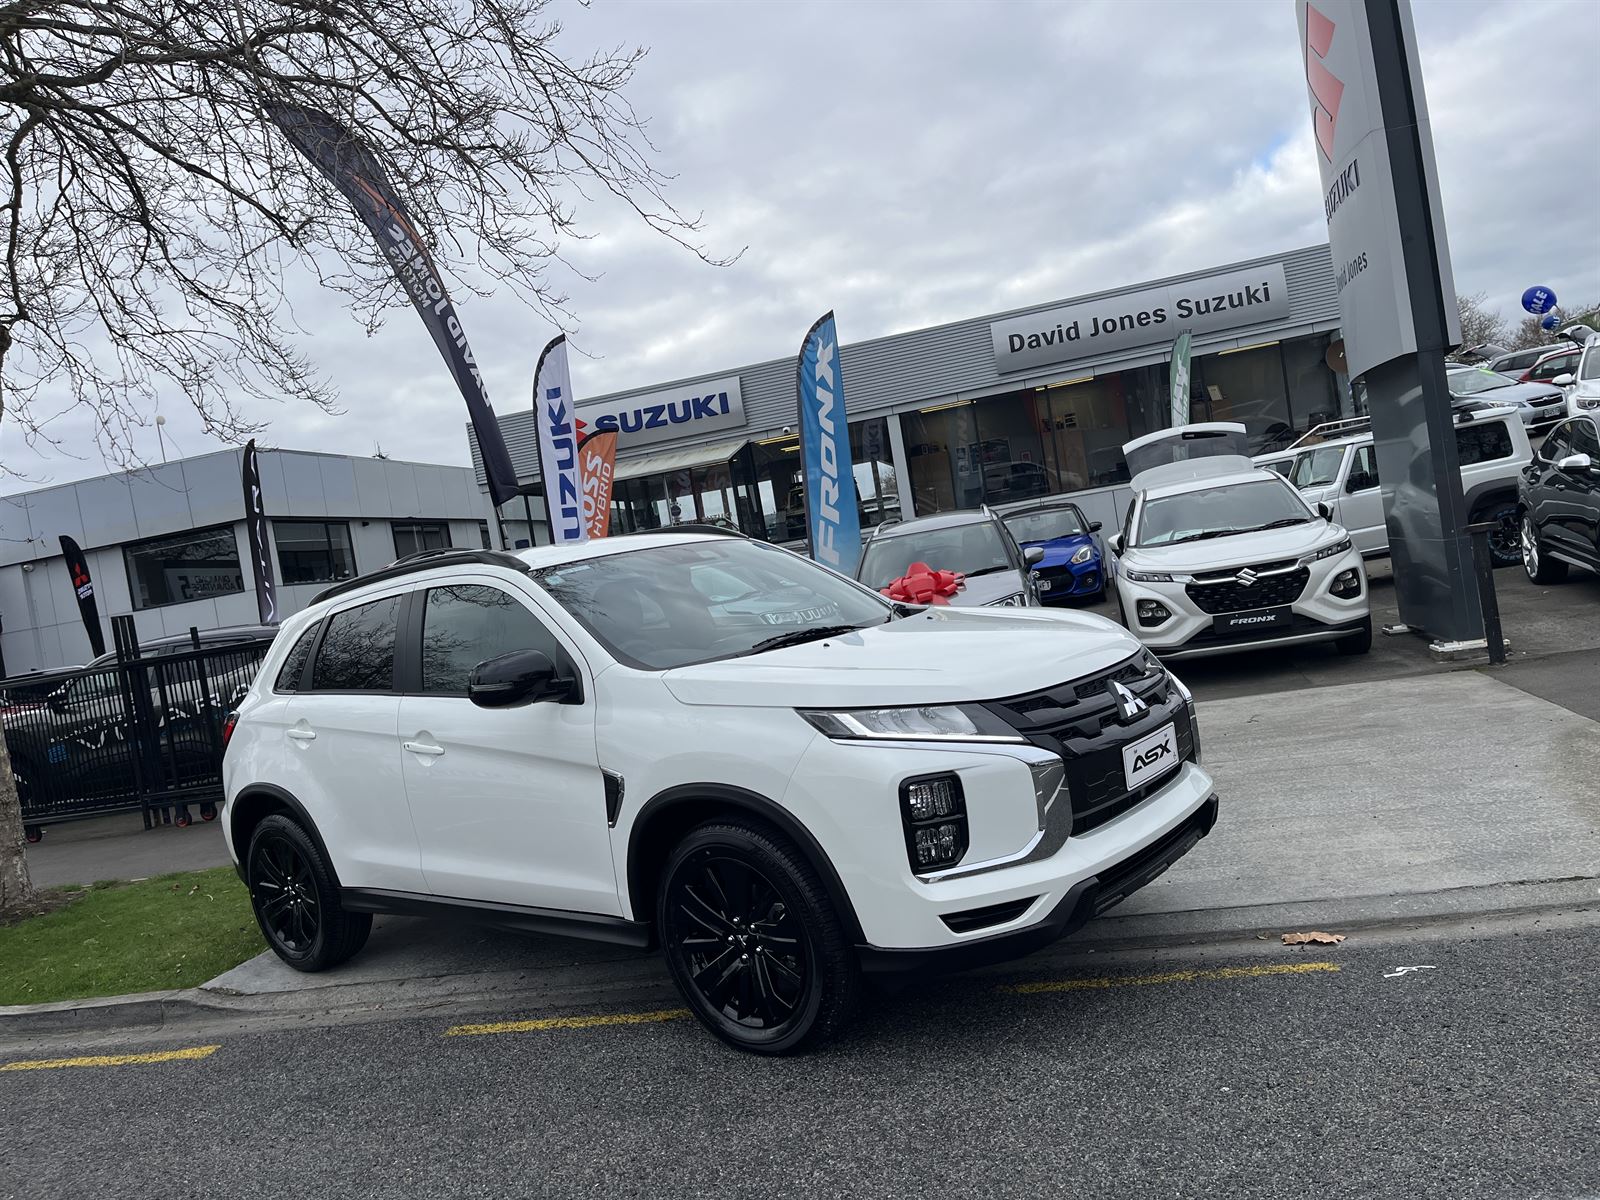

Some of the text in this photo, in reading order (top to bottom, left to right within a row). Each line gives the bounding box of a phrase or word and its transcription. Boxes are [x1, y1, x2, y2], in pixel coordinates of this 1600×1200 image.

[1325, 159, 1361, 225] SUZUKI
[1347, 251, 1368, 283] Jones
[1008, 281, 1271, 354] David Jones Suzuki
[595, 392, 730, 434] SUZUKI
[546, 386, 581, 540] UZUKI
[814, 337, 842, 565] FRONX
[593, 462, 611, 536] HYBRID
[1229, 612, 1277, 627] FRONX
[1132, 738, 1172, 774] ASX
